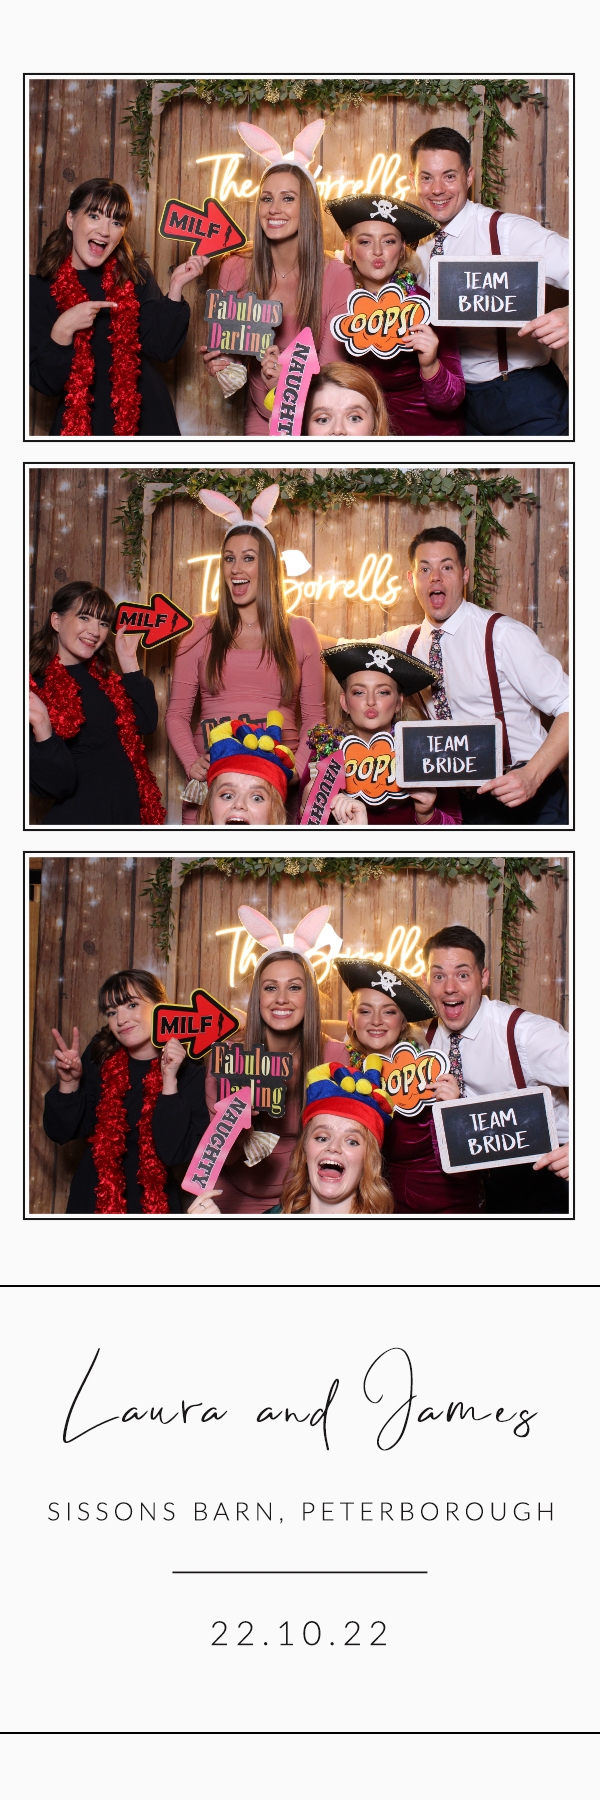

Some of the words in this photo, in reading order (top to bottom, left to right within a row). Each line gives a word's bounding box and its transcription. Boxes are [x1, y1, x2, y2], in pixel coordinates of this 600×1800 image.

[196, 153, 260, 201] The
[312, 152, 411, 200] orrells
[168, 211, 221, 239] MILF
[464, 271, 509, 290] TEAM
[207, 292, 281, 325] Fabulous
[458, 294, 517, 313] BRIDE
[348, 303, 421, 338] OOPS!
[209, 322, 272, 360] Darling
[277, 341, 311, 436] NAUGHT
[119, 610, 168, 628] MILF
[427, 735, 469, 752] TEAM
[422, 756, 477, 774] BRIDE
[160, 1015, 213, 1035] MILF
[213, 1045, 290, 1077] Fabulous
[380, 1055, 436, 1096] OPS!
[219, 1077, 283, 1115] Dling
[468, 1108, 517, 1130] TEAM
[193, 1096, 248, 1188] NAUGHTY
[466, 1130, 529, 1156] BRIDE
